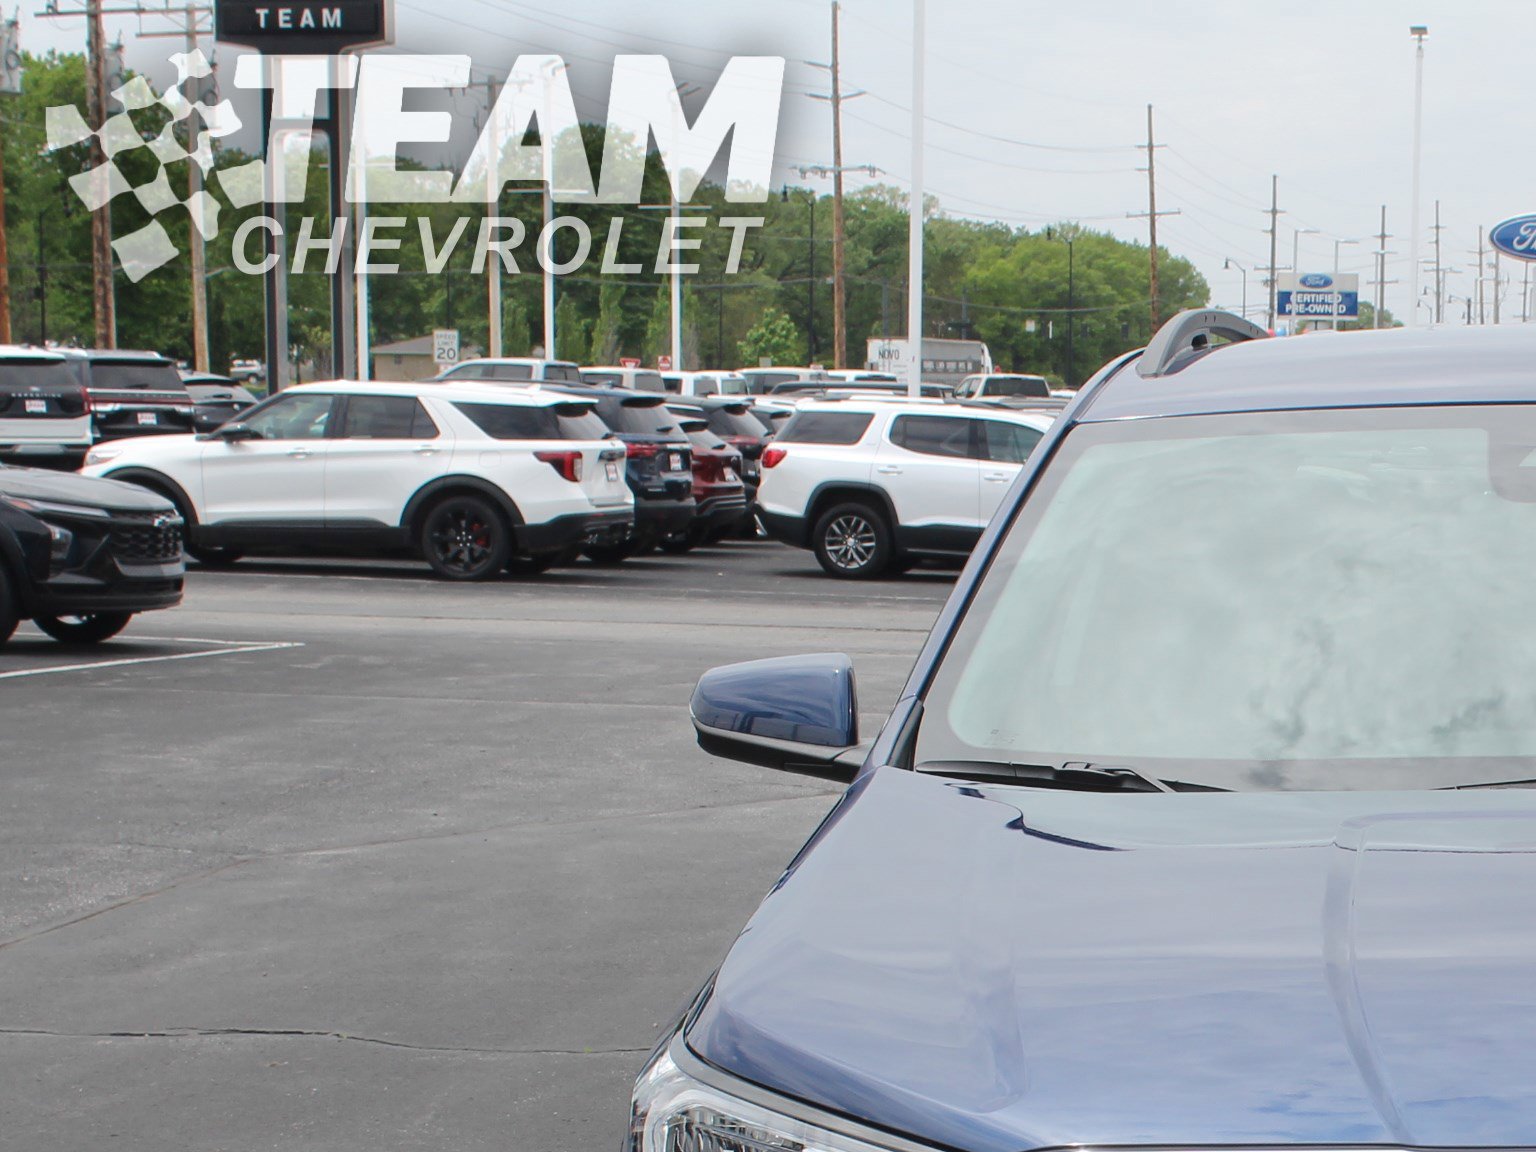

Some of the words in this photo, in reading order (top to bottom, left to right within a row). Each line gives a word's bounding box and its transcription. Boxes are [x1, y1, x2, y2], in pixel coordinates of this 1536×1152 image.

[255, 7, 342, 29] TEAM
[1285, 303, 1346, 314] PRE-OWND
[436, 347, 456, 360] 20
